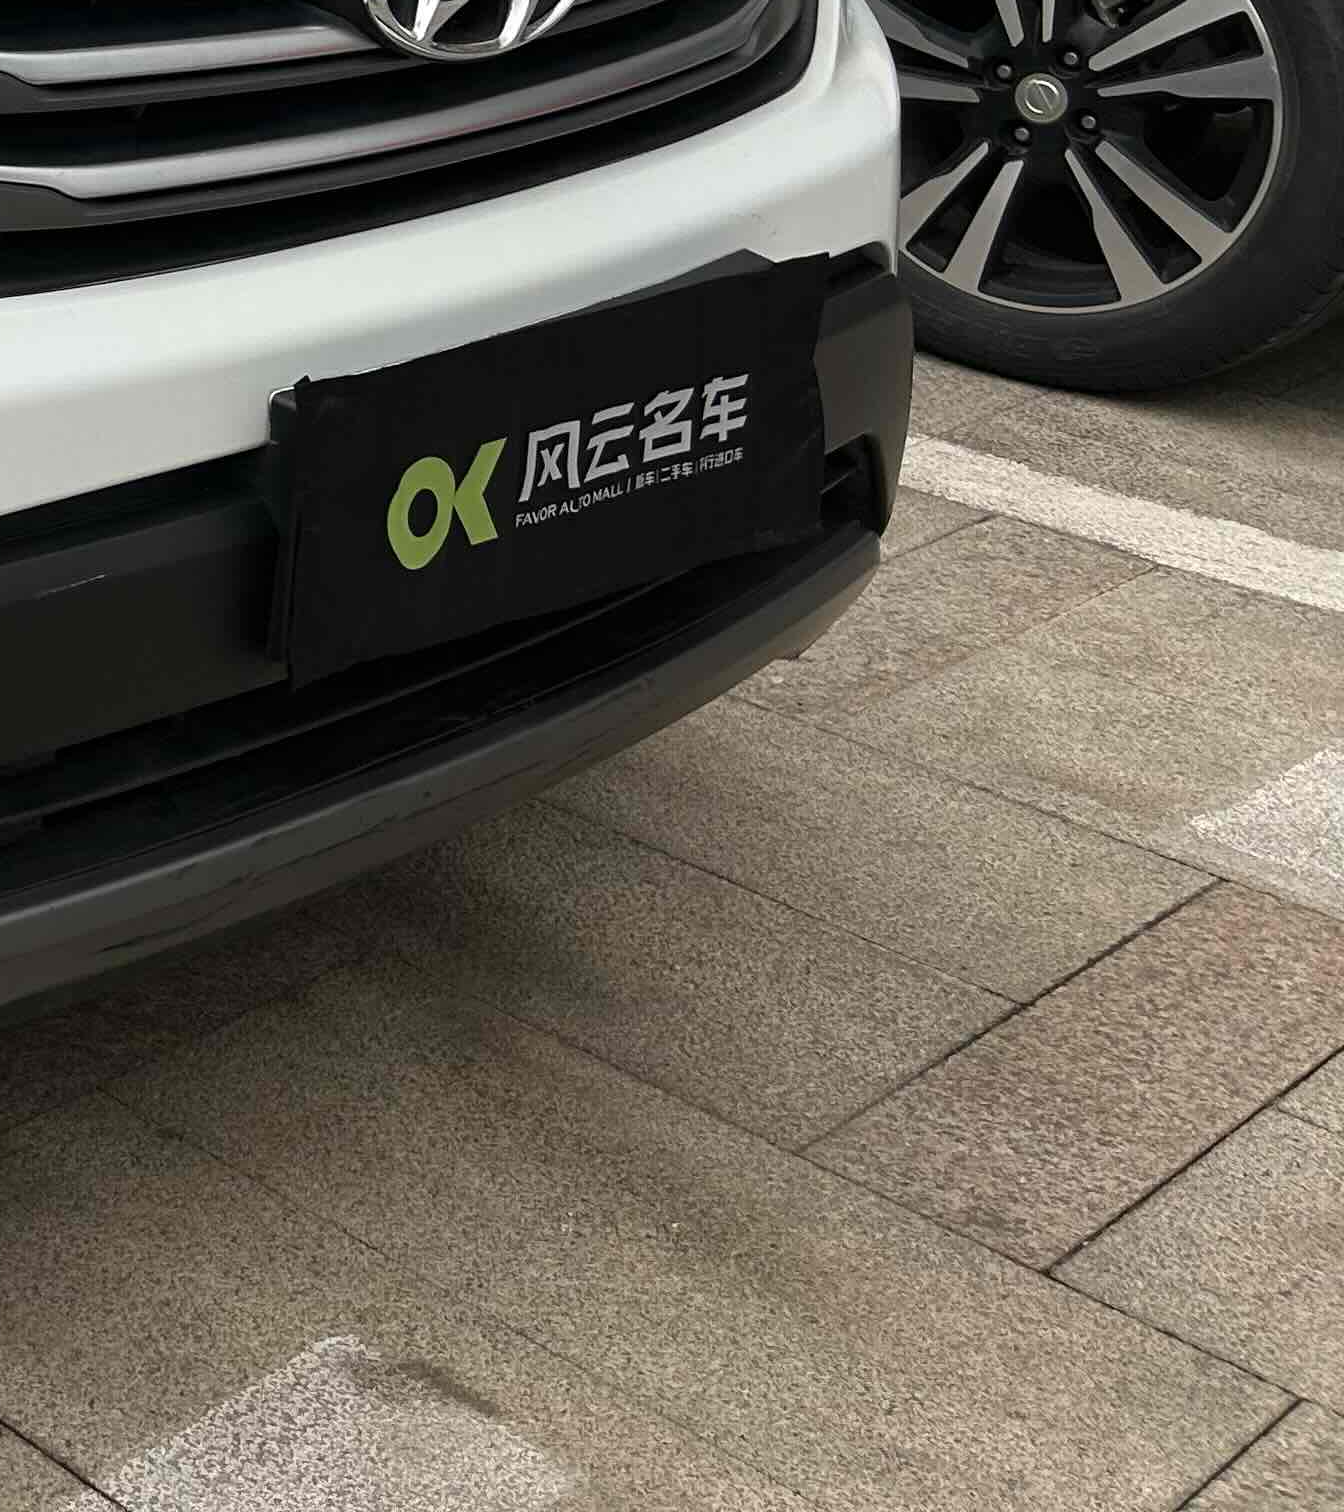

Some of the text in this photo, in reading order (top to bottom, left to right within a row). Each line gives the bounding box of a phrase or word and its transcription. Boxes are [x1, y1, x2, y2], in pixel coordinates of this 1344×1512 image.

[517, 372, 750, 503] 风云名车
[387, 438, 508, 571] OK
[515, 503, 557, 528] FAVOR
[592, 481, 624, 504] MALL
